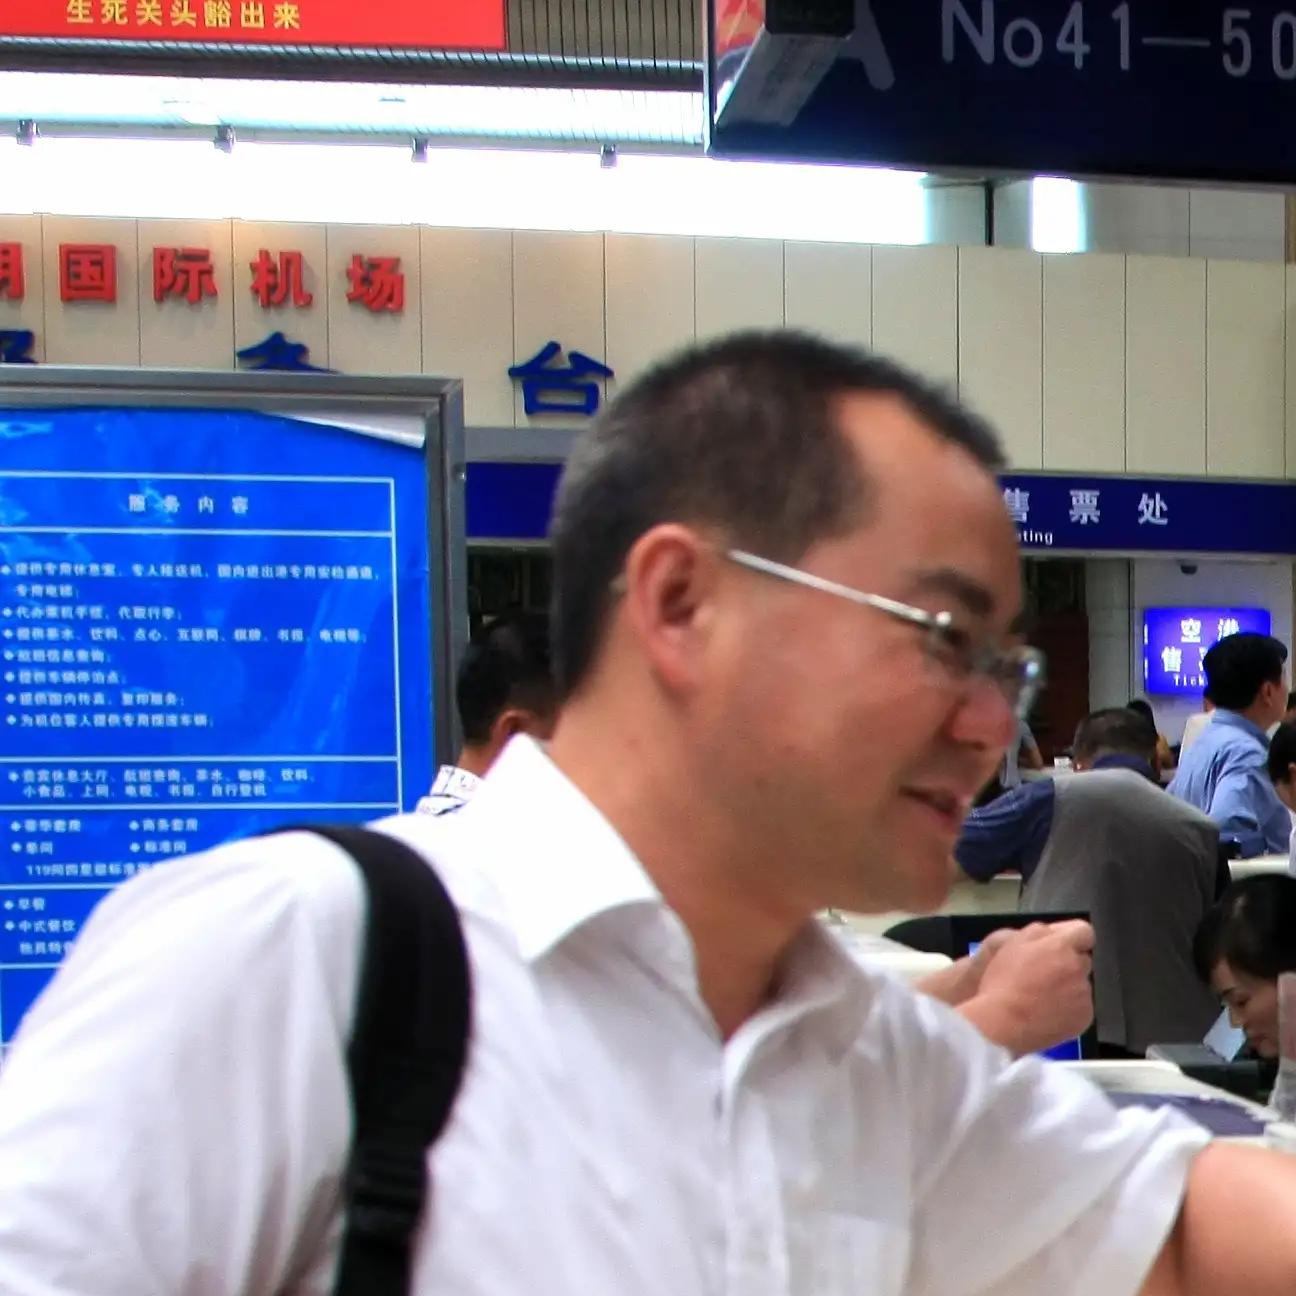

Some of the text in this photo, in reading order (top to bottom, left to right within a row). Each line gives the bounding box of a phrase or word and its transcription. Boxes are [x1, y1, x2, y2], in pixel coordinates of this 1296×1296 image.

[66, 0, 301, 29] 生死关头豁出来
[128, 493, 249, 515] 服务内容
[1004, 487, 1169, 526] 售票处
